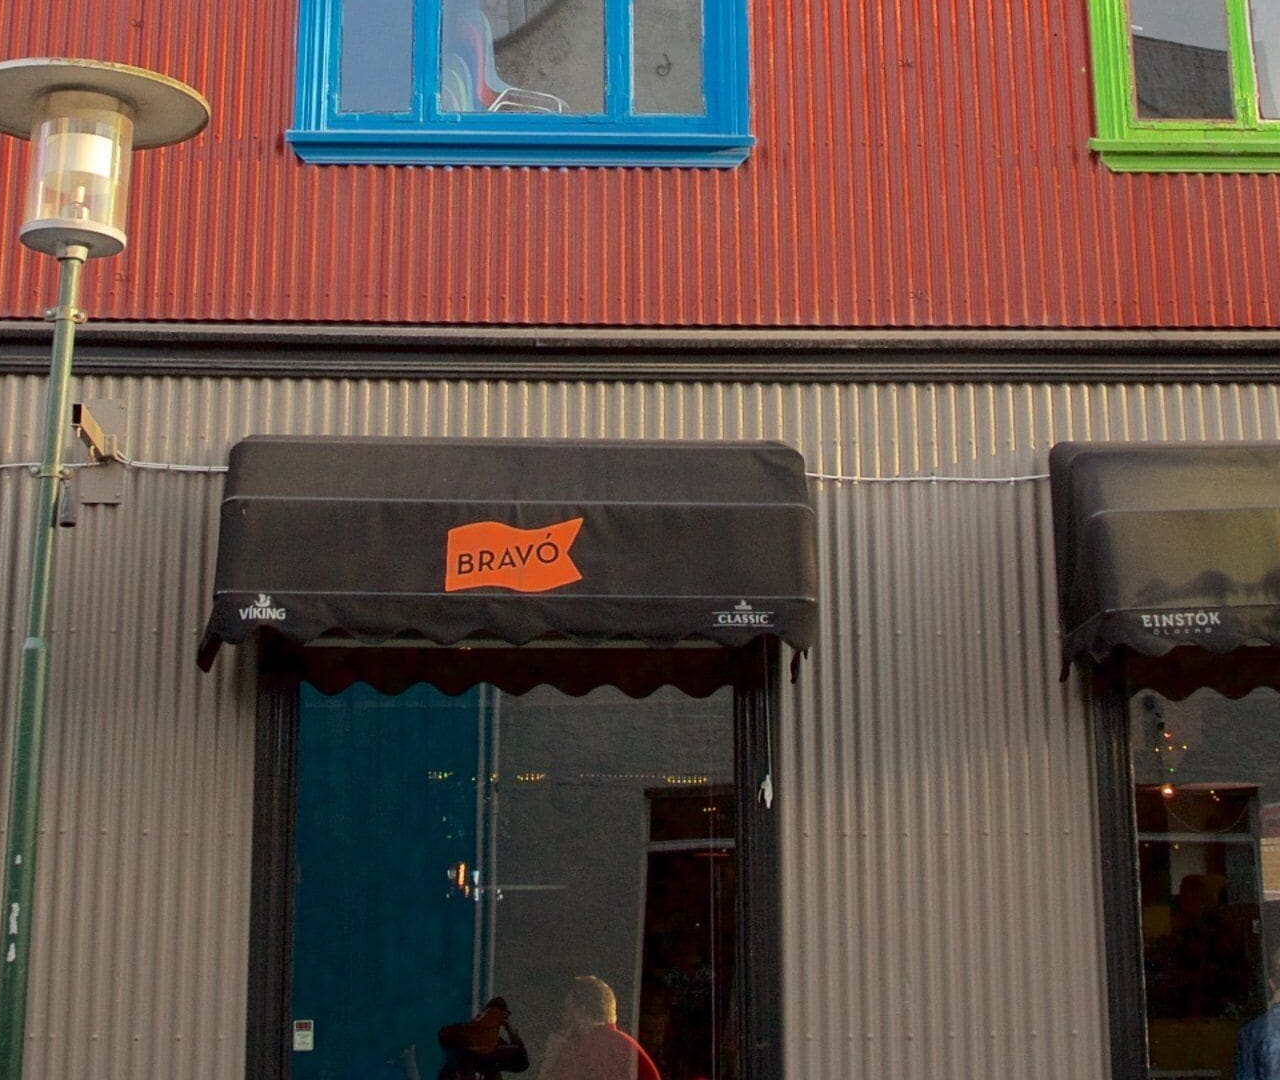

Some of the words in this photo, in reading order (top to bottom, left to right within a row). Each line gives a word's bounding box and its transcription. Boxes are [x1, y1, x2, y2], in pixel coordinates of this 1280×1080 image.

[458, 533, 559, 574] BRAVÓ
[239, 605, 286, 620] VÍKING
[718, 614, 769, 624] CLASSIC
[1141, 610, 1221, 627] EINSTÖK
